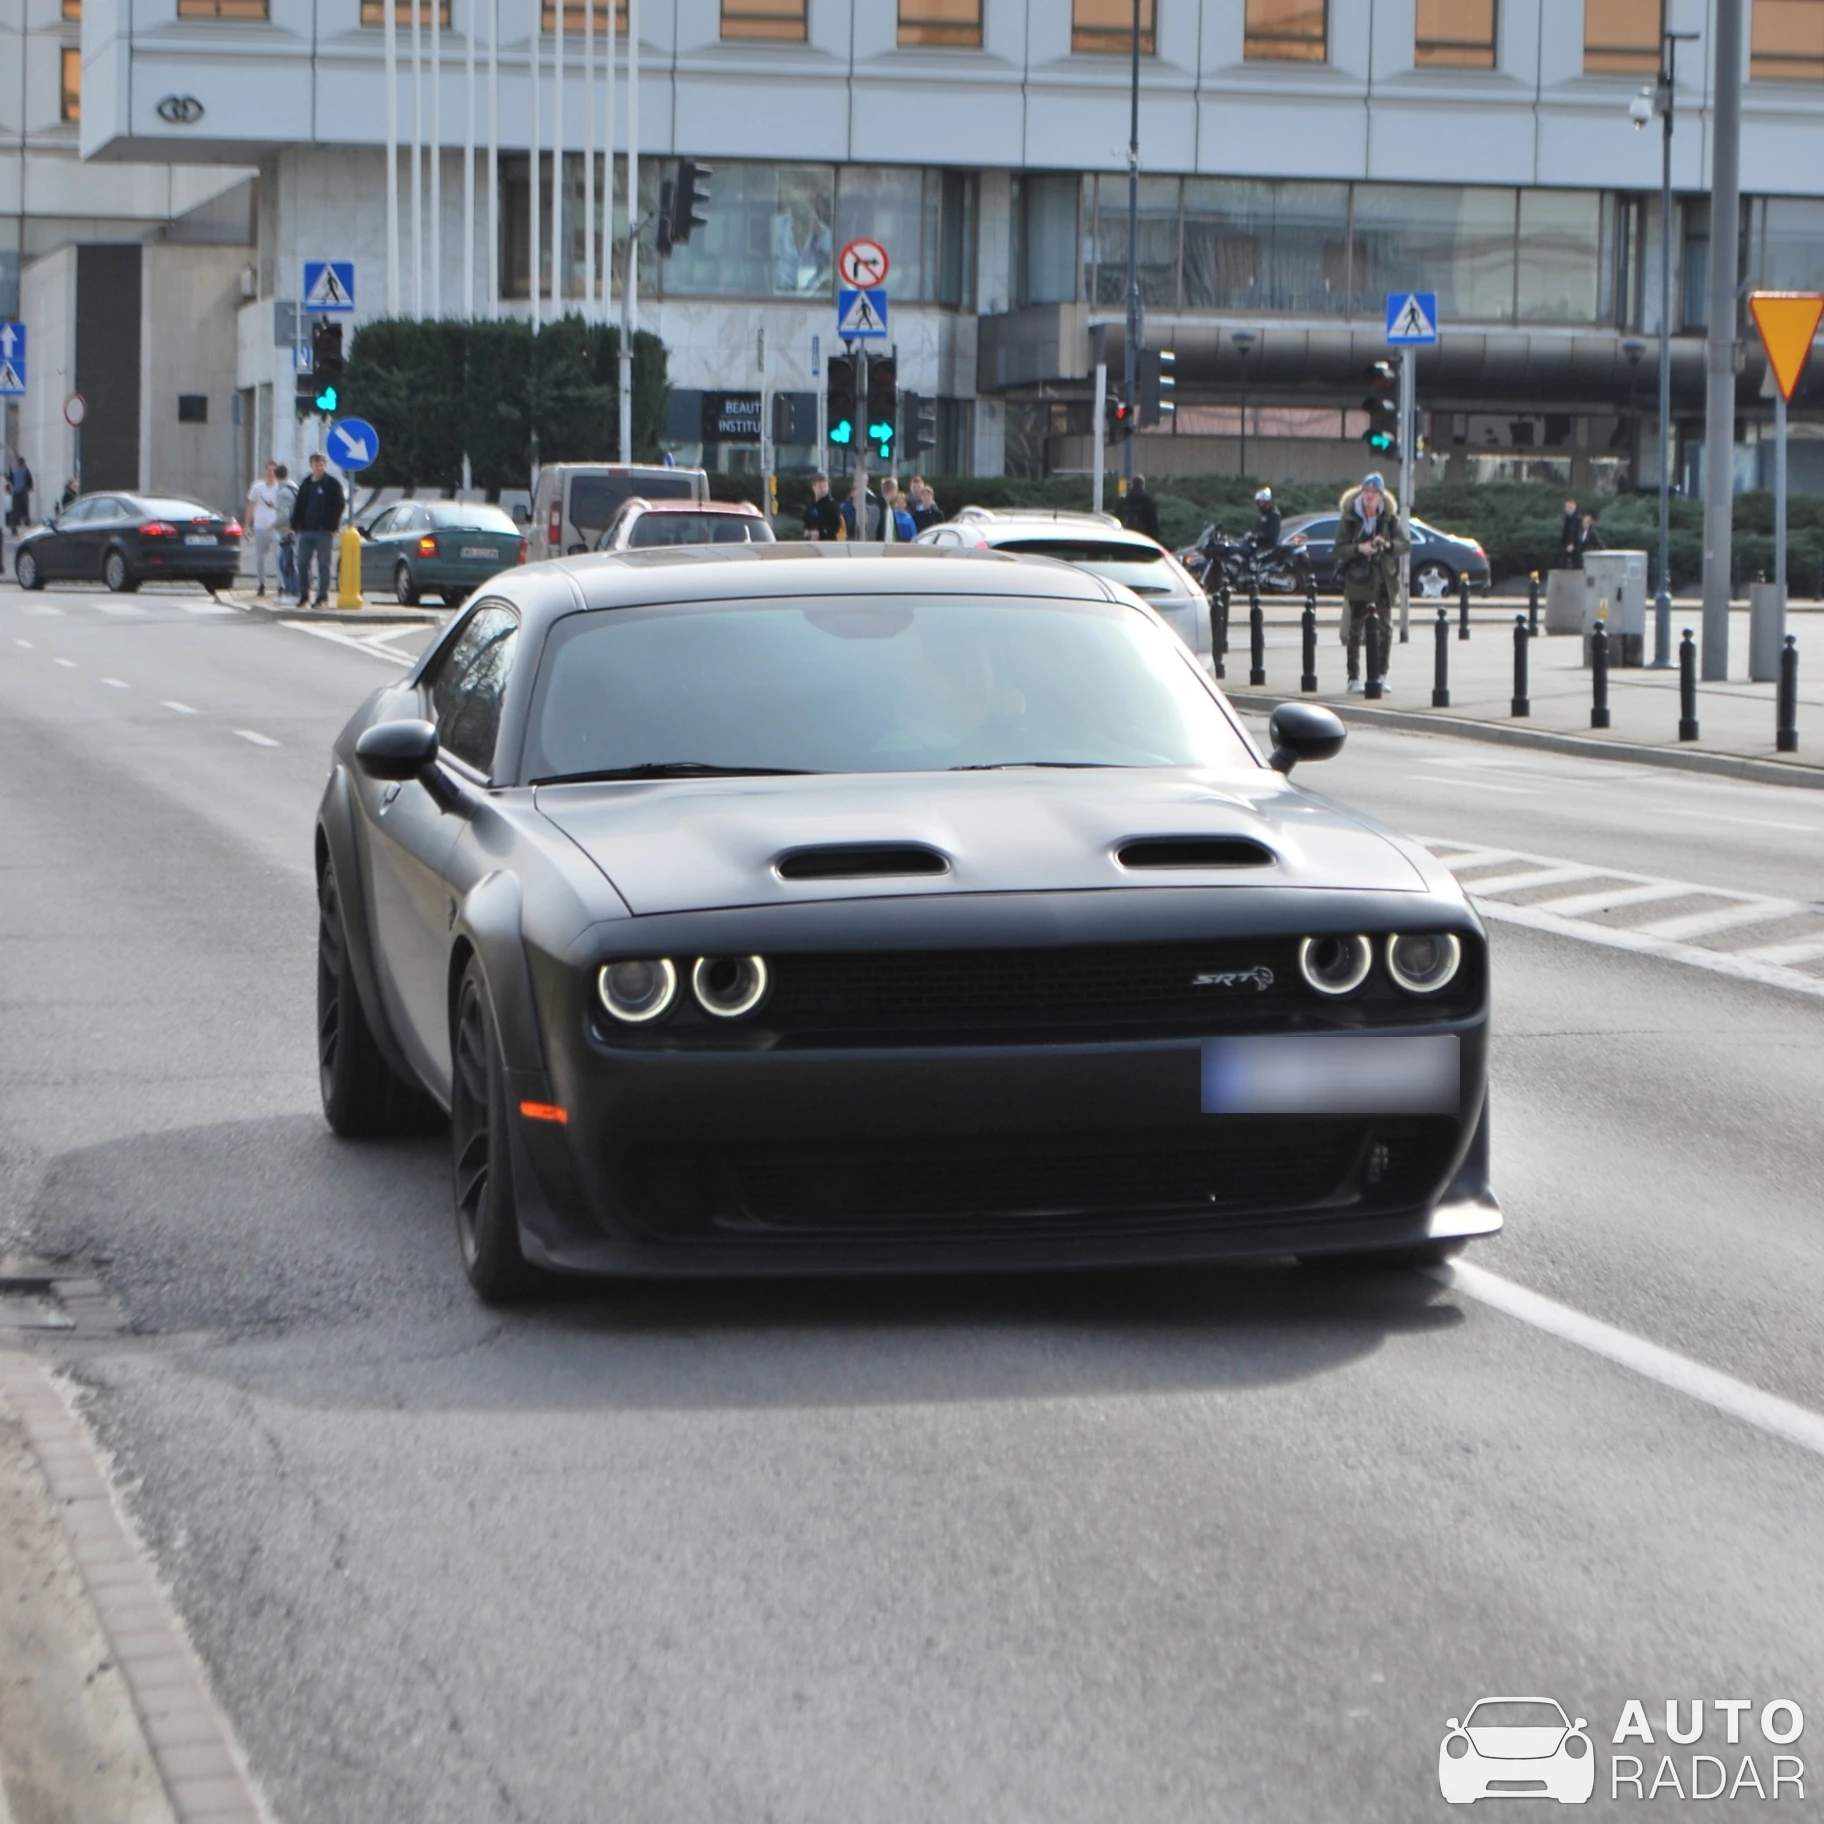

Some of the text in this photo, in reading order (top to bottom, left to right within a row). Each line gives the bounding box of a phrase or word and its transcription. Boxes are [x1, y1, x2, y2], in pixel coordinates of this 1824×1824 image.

[725, 401, 761, 414] BEAUT
[719, 420, 761, 433] INSTITU
[1193, 973, 1257, 987] SRT
